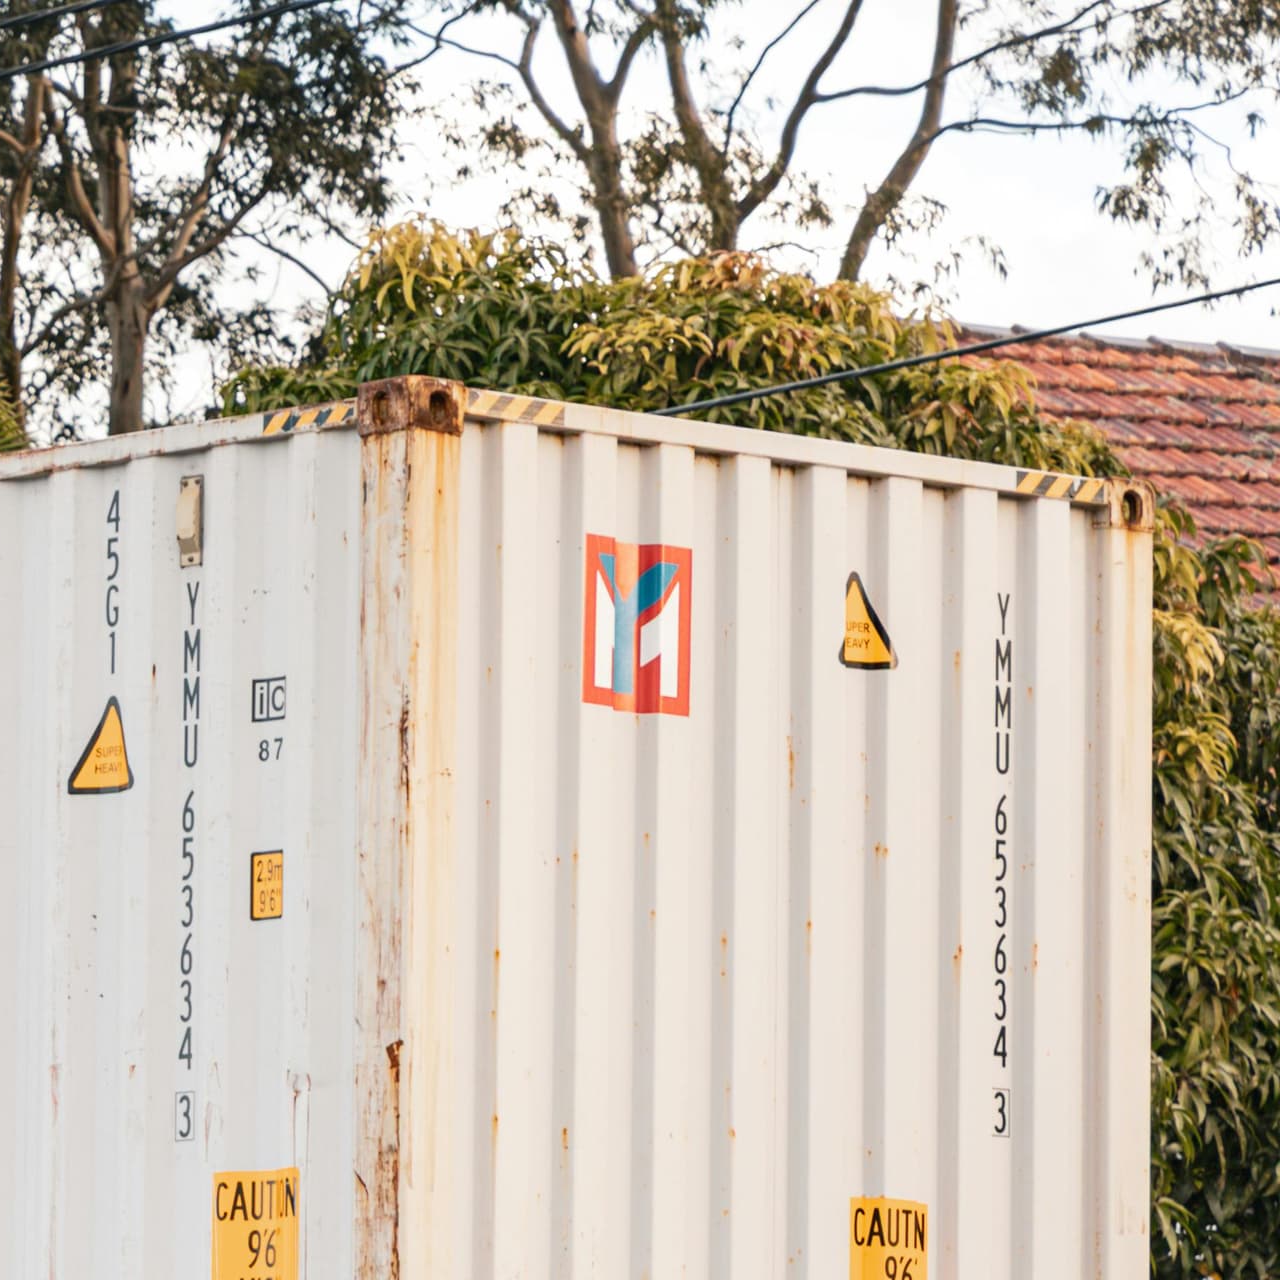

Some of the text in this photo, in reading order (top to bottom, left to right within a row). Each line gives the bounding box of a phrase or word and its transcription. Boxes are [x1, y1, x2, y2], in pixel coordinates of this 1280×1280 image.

[105, 489, 121, 675] 45G1
[846, 621, 870, 633] UPER
[846, 637, 870, 649] EAVY
[258, 737, 283, 762] 87
[94, 761, 123, 775] HEAV
[177, 581, 201, 1139] YMMU 653634 3
[993, 592, 1012, 1134] YMMU 653634 3
